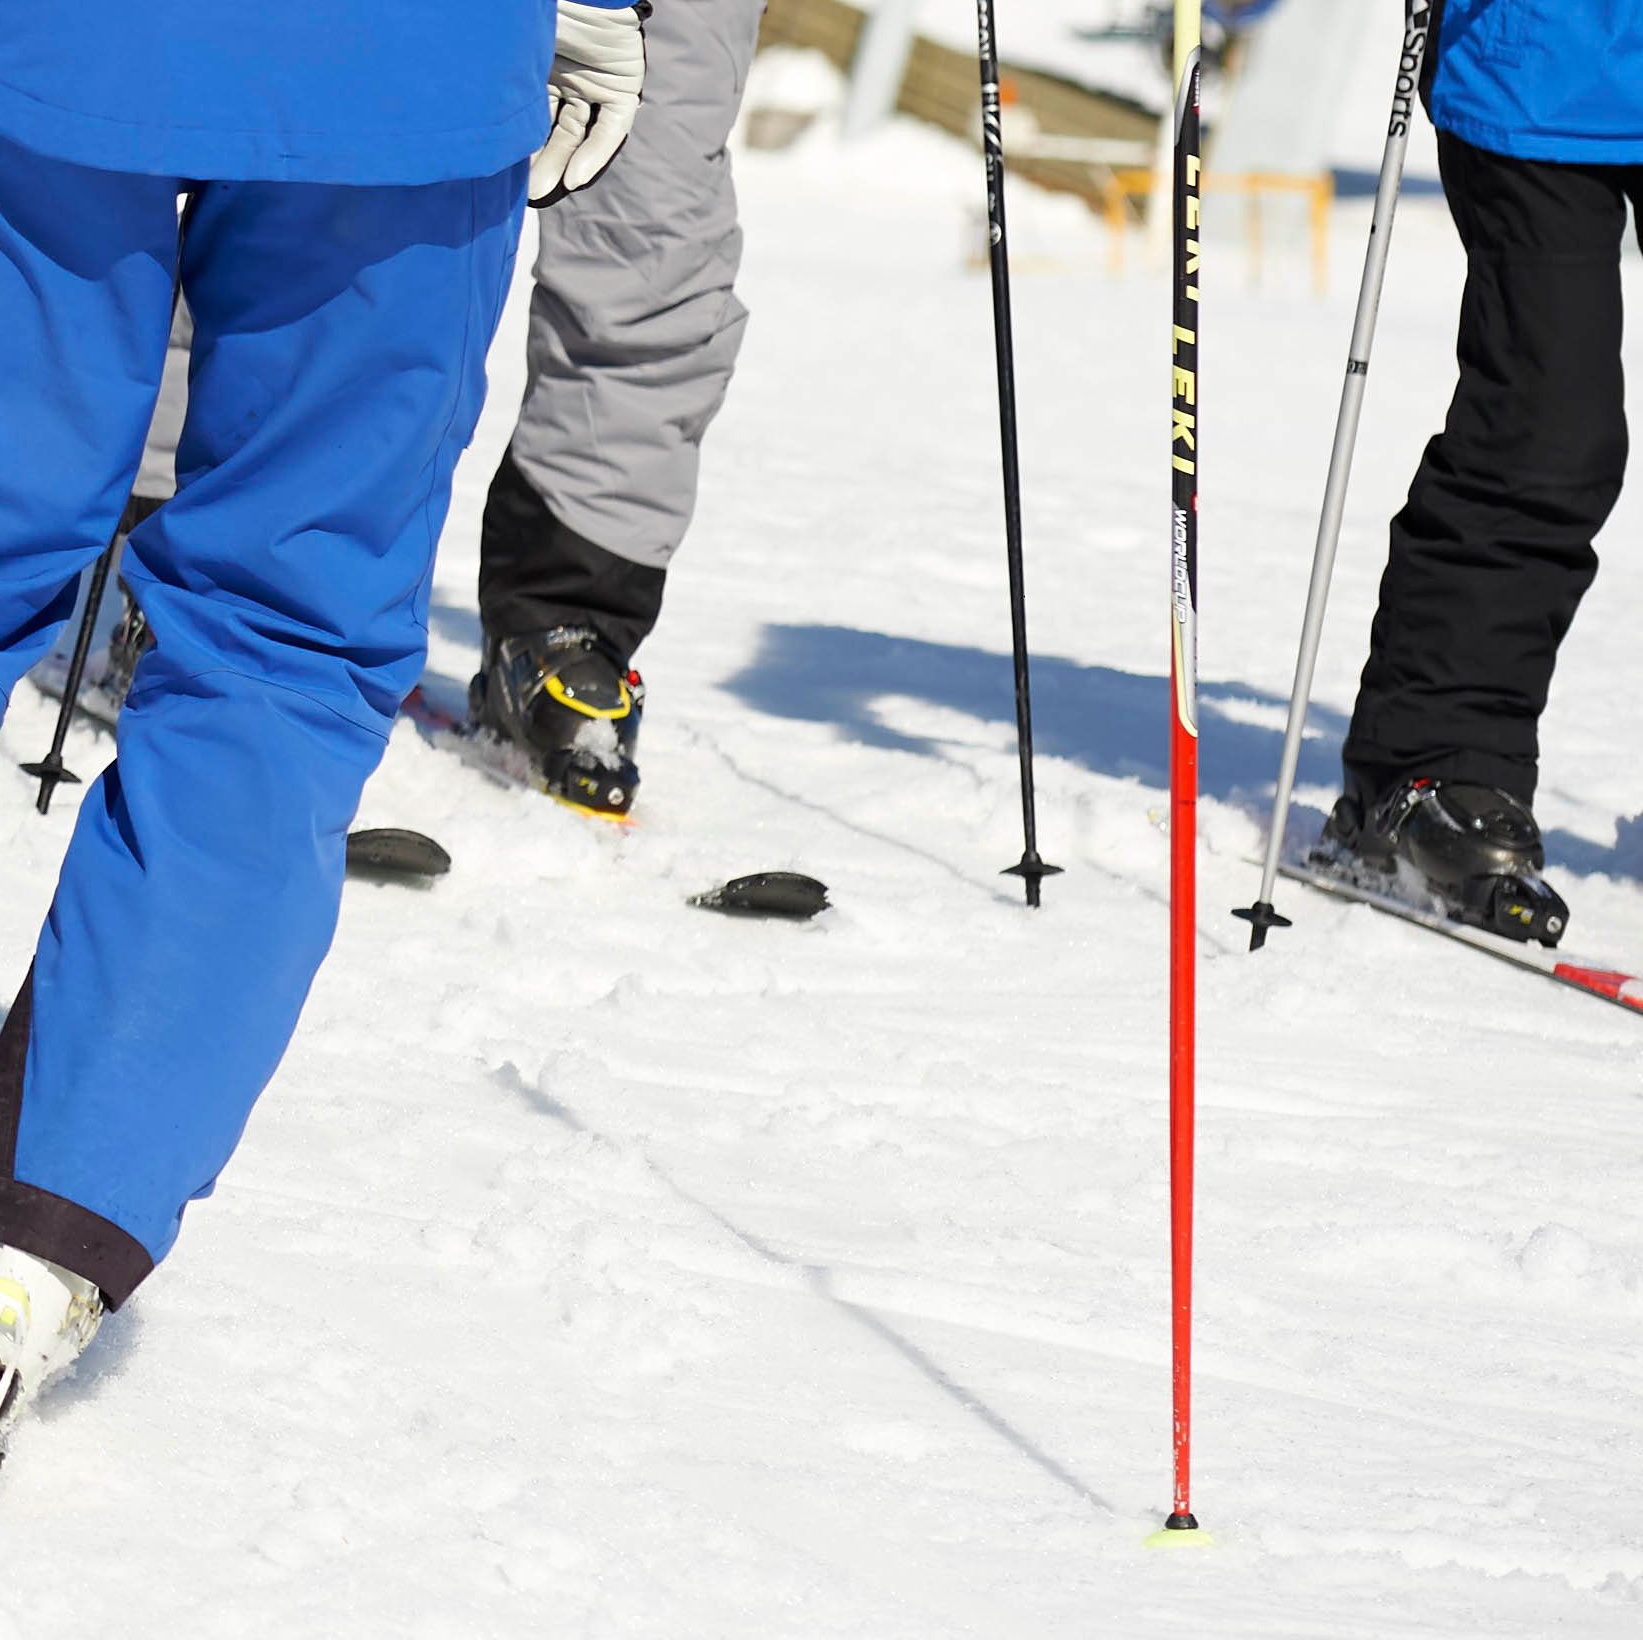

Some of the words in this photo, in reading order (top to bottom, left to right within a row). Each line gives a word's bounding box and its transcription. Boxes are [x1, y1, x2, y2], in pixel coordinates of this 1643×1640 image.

[1388, 30, 1427, 139] Sports
[1171, 322, 1196, 477] LEKI
[1174, 508, 1188, 626] WORLDCUP
